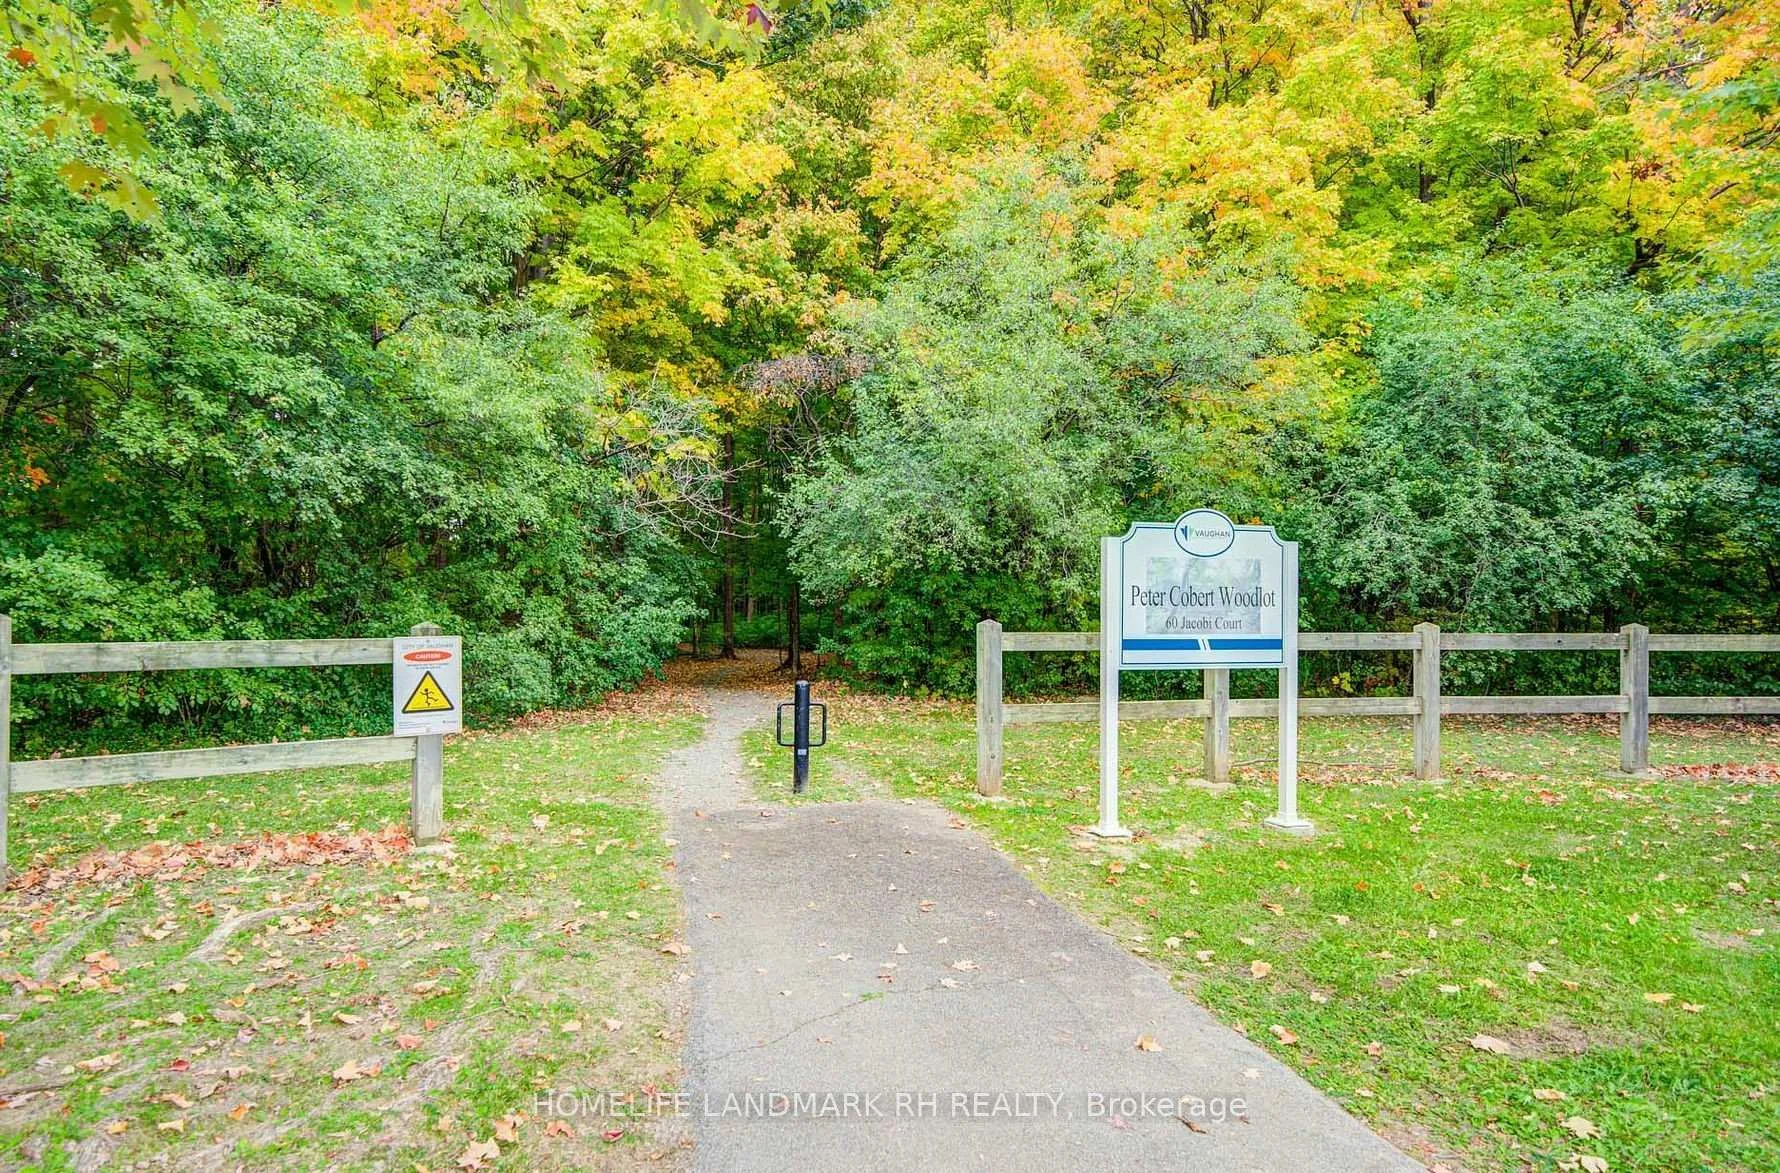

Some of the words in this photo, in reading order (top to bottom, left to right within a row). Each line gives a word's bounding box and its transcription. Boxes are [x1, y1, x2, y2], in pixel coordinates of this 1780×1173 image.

[1194, 529, 1230, 537] VAUGHAN
[1131, 585, 1166, 606] Peter
[1169, 585, 1214, 607] Cobert
[1218, 585, 1276, 607] Woodlot
[1165, 617, 1178, 629] 60
[1180, 616, 1213, 630] Jacobi
[1214, 617, 1242, 630] Court
